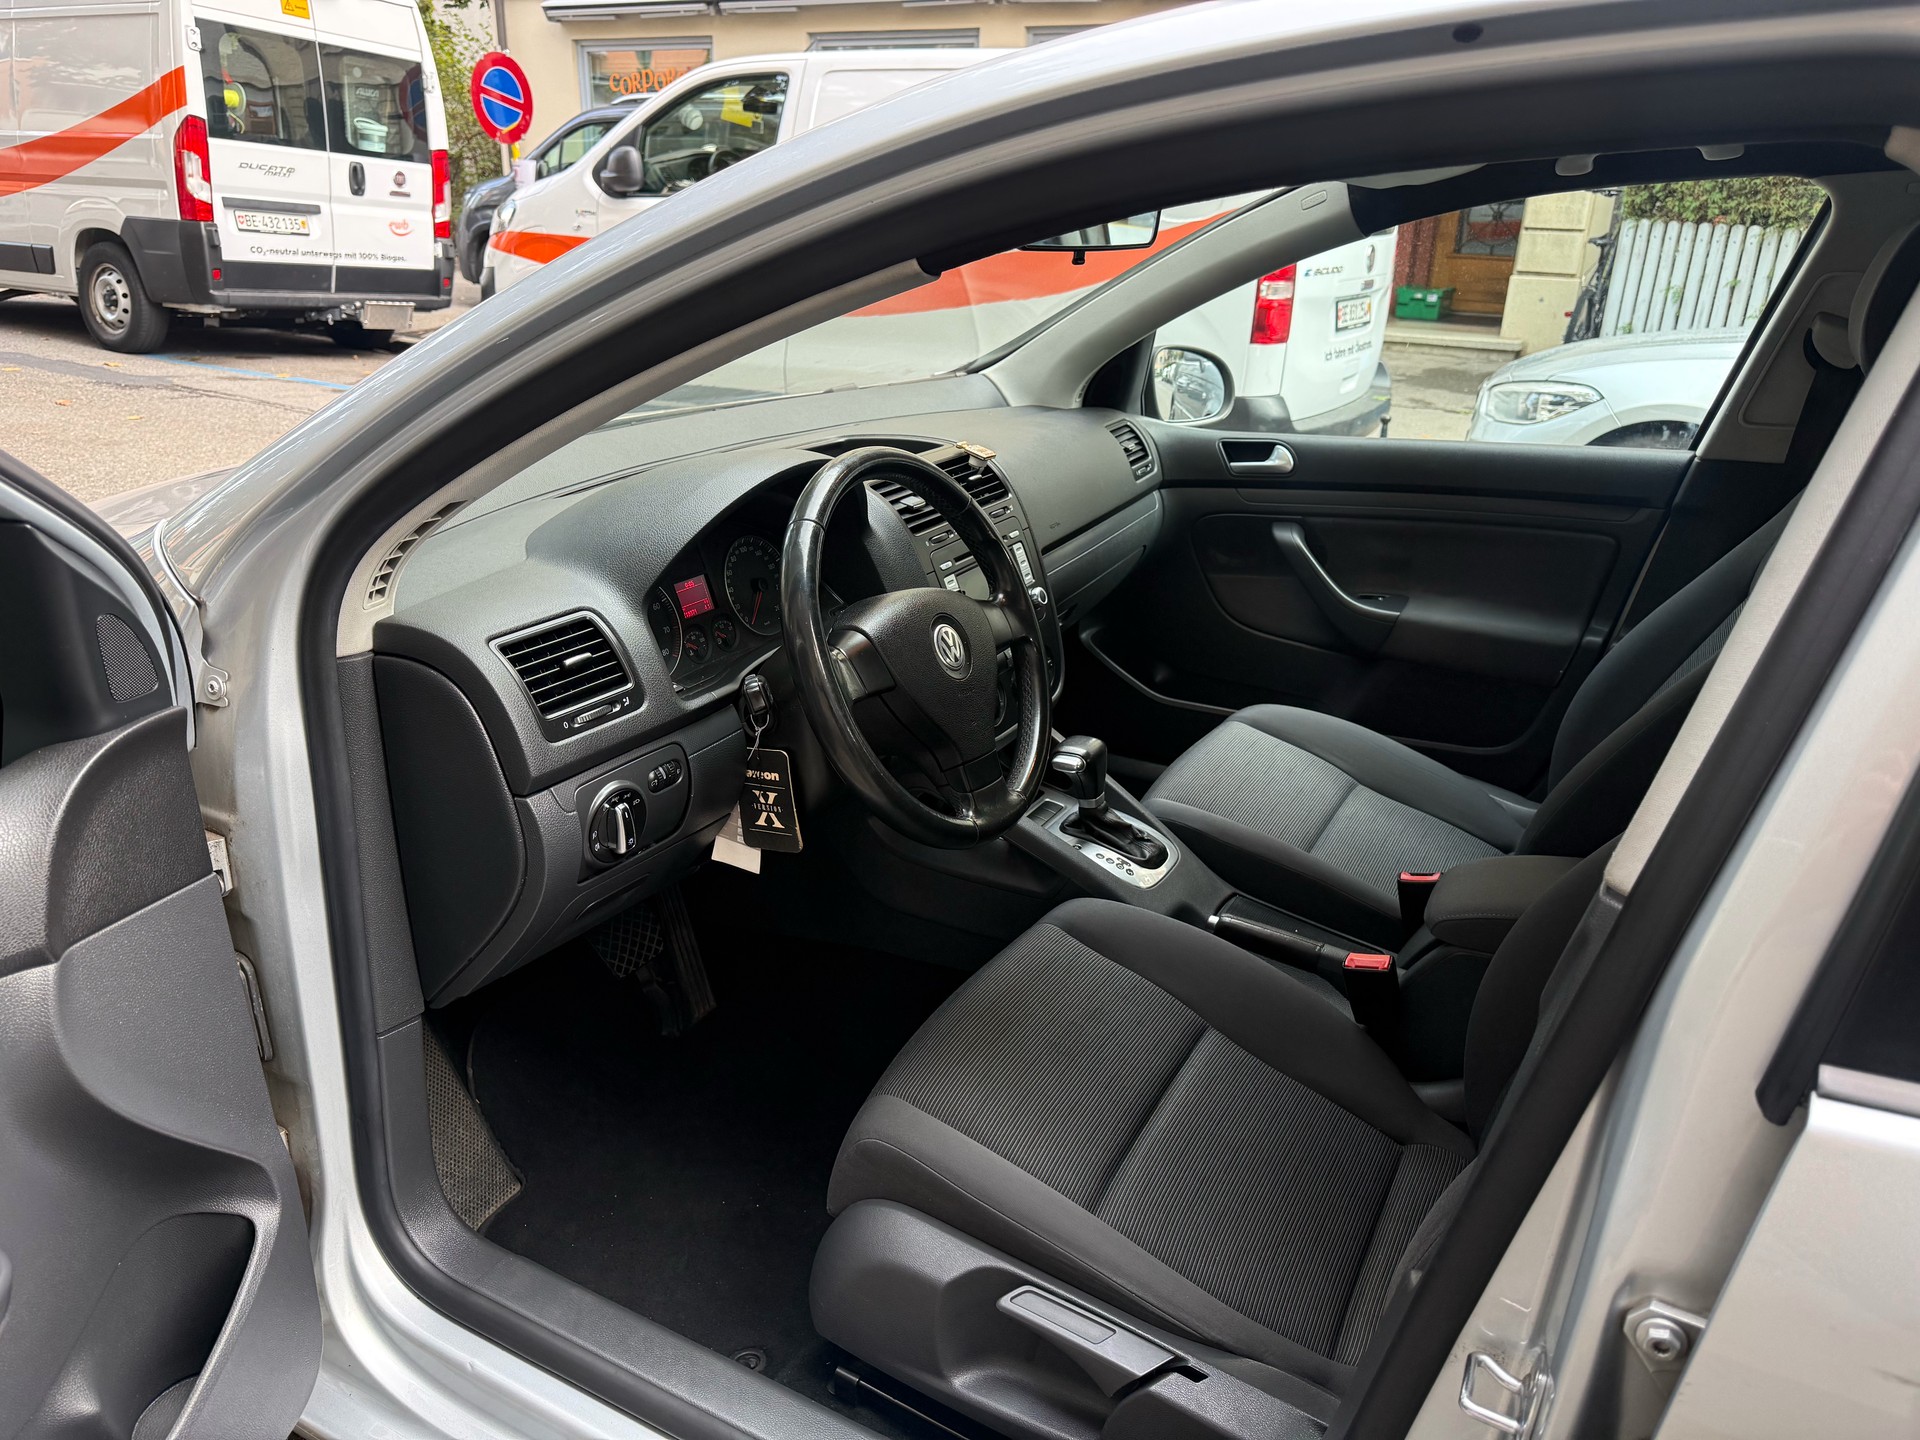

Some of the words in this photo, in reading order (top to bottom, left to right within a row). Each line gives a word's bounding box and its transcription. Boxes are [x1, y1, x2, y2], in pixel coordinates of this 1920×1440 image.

[609, 67, 684, 95] CORPOR
[301, 249, 342, 260] unterwegs
[344, 251, 357, 259] mit
